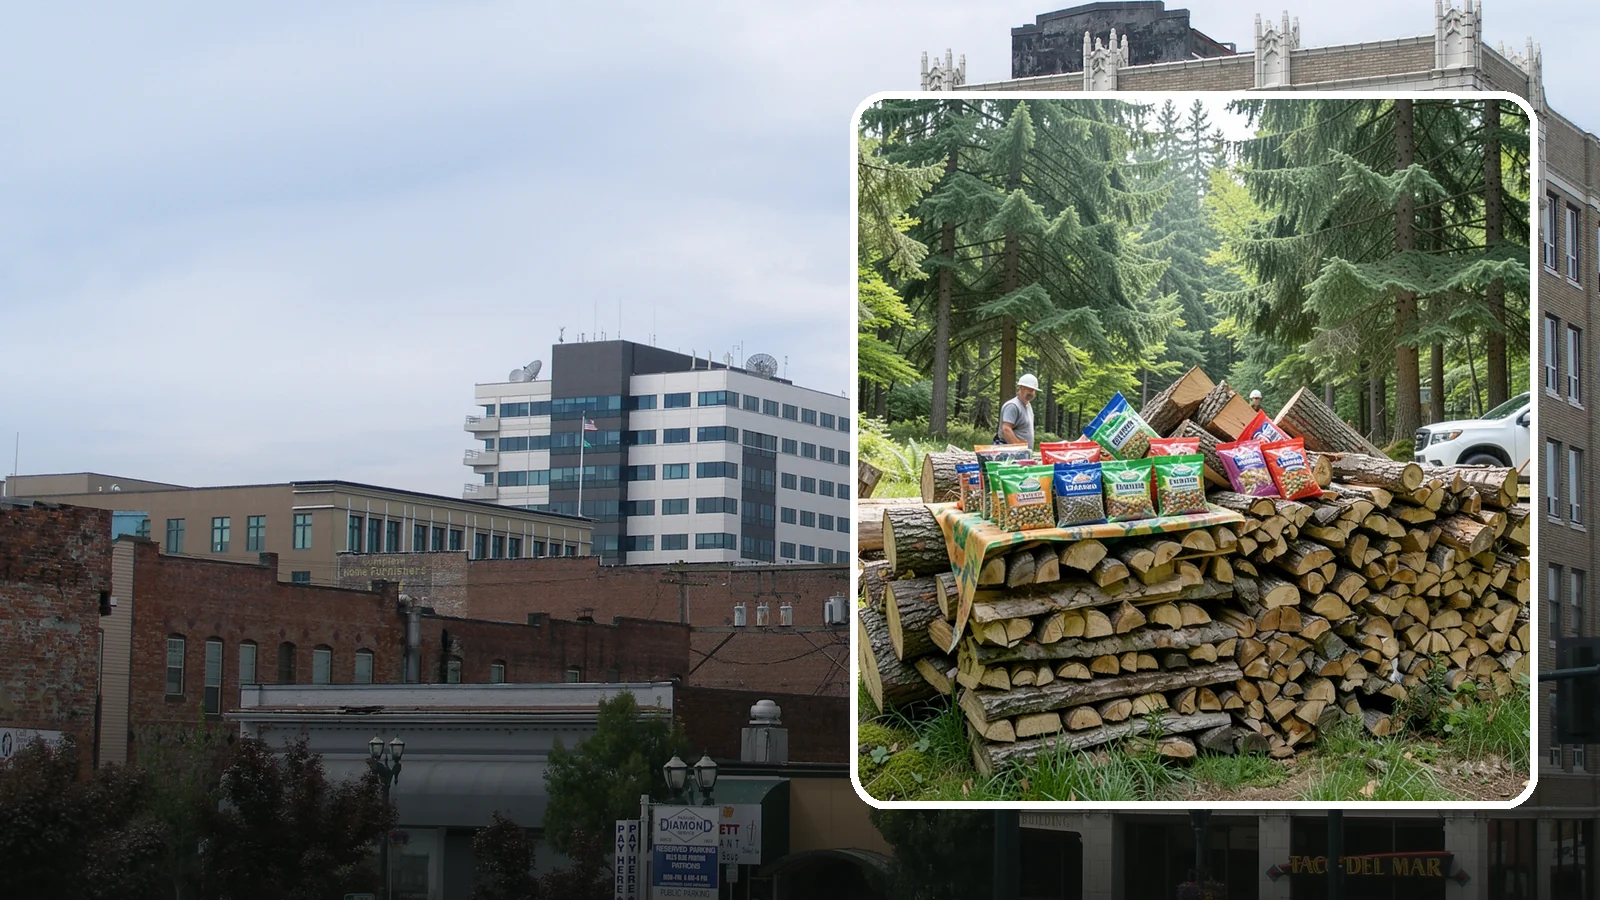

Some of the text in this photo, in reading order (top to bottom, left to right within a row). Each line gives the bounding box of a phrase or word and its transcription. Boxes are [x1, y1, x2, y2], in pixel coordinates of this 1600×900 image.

[343, 566, 427, 577] Home Furnishers
[660, 818, 713, 833] DIAMOND
[1022, 815, 1070, 828] BUILDING
[656, 845, 716, 854] RESERVED PARKING
[616, 825, 625, 893] PAY HERE
[627, 824, 637, 893] PAY HERE
[671, 862, 701, 870] PATRONS
[1346, 857, 1384, 876] DEL
[1392, 857, 1442, 877] MAR
[660, 889, 710, 899] PUBLIC PARKING
